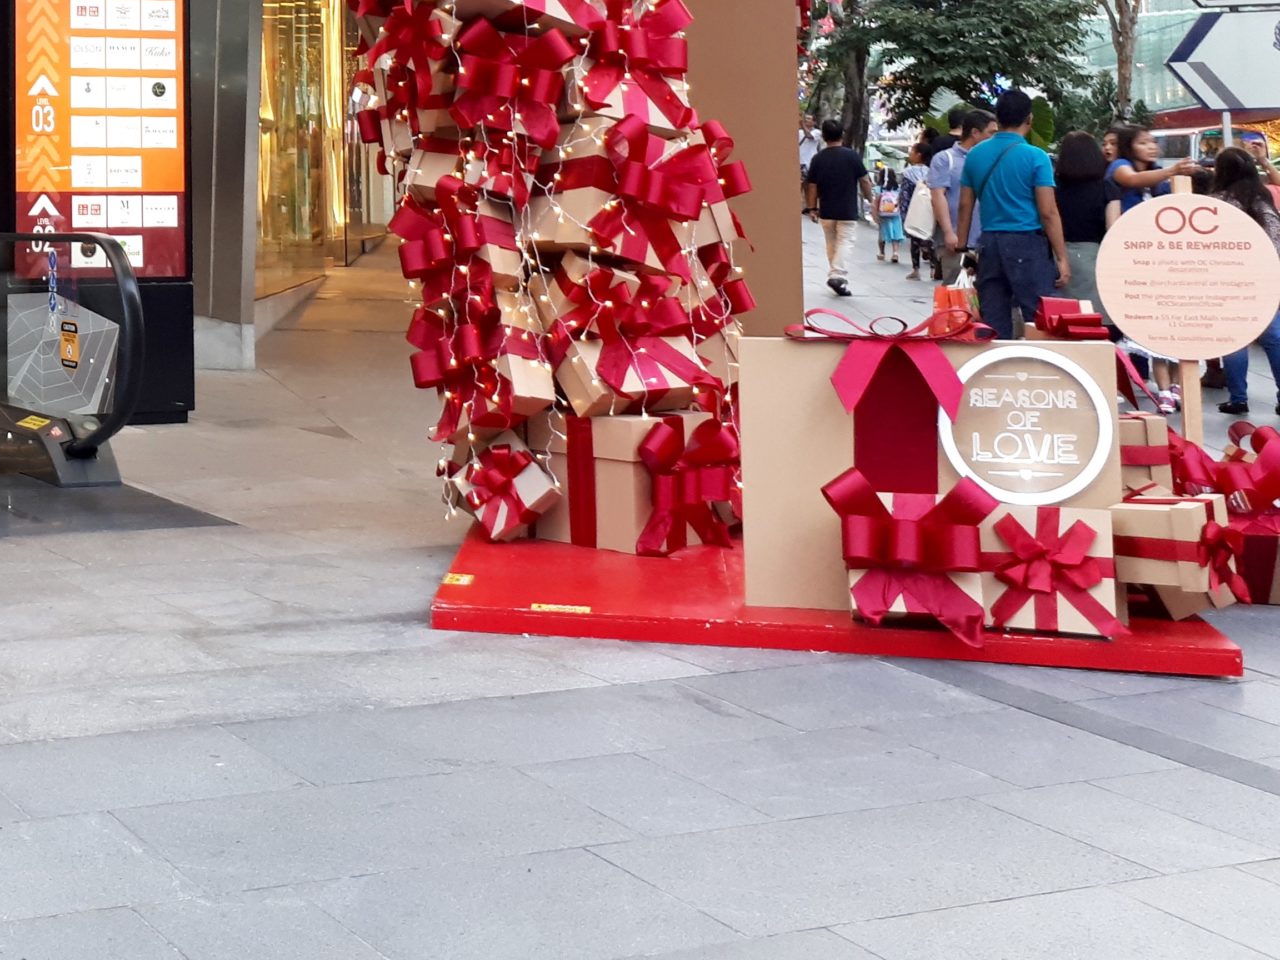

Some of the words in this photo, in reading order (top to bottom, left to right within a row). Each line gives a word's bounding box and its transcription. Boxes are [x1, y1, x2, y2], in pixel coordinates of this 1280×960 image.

[31, 105, 55, 132] 03
[1154, 206, 1220, 235] OC
[32, 225, 55, 252] 02
[1123, 241, 1154, 250] SNAP
[1157, 242, 1166, 250] &
[1168, 242, 1183, 250] BE
[1186, 241, 1252, 250] REWARDED
[969, 388, 1078, 409] SEASONS
[1007, 411, 1042, 430] OF
[971, 432, 1080, 465] LOVE
